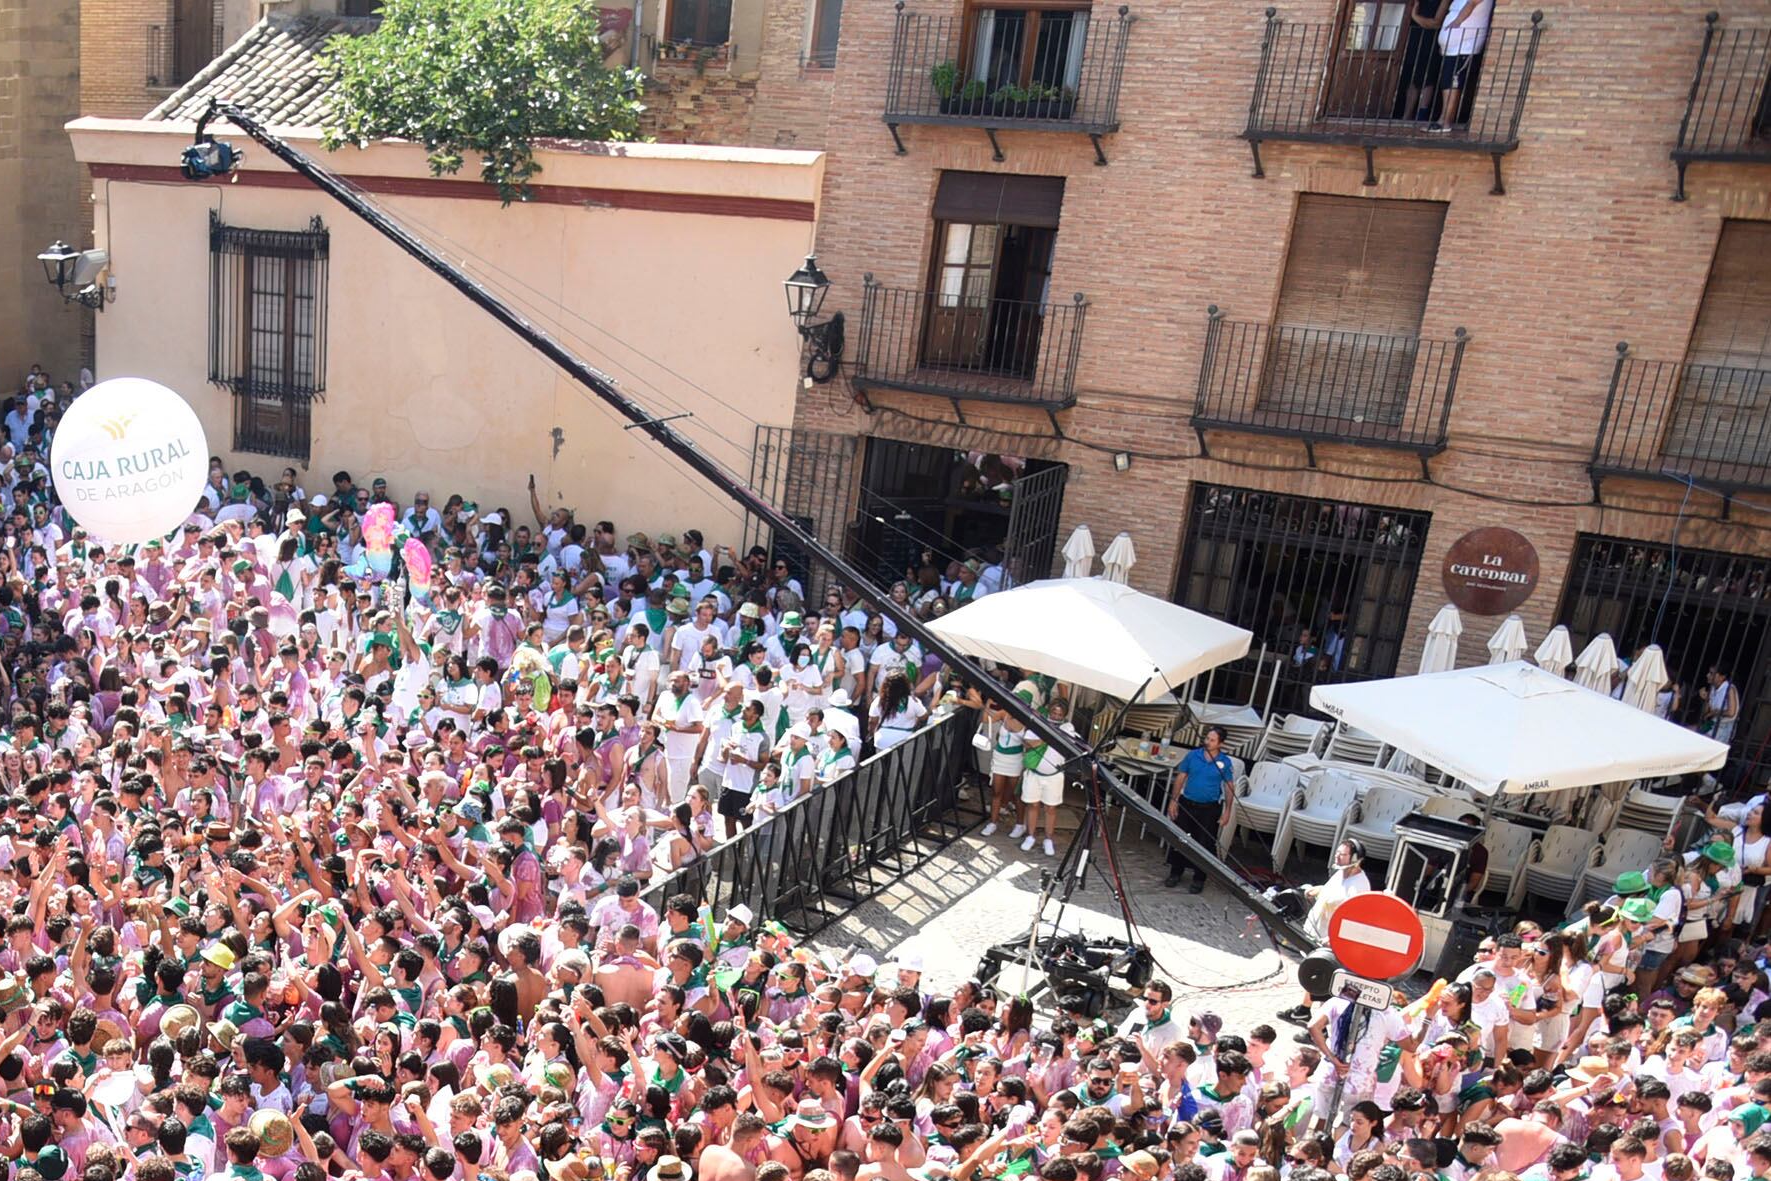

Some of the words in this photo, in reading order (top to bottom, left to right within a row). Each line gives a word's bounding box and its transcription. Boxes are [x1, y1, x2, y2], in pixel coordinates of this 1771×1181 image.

[62, 460, 111, 481] CAJA
[117, 438, 190, 477] RURAL
[76, 487, 101, 501] DE
[105, 467, 184, 500] ARAGÓN
[1522, 779, 1549, 791] AMBAR
